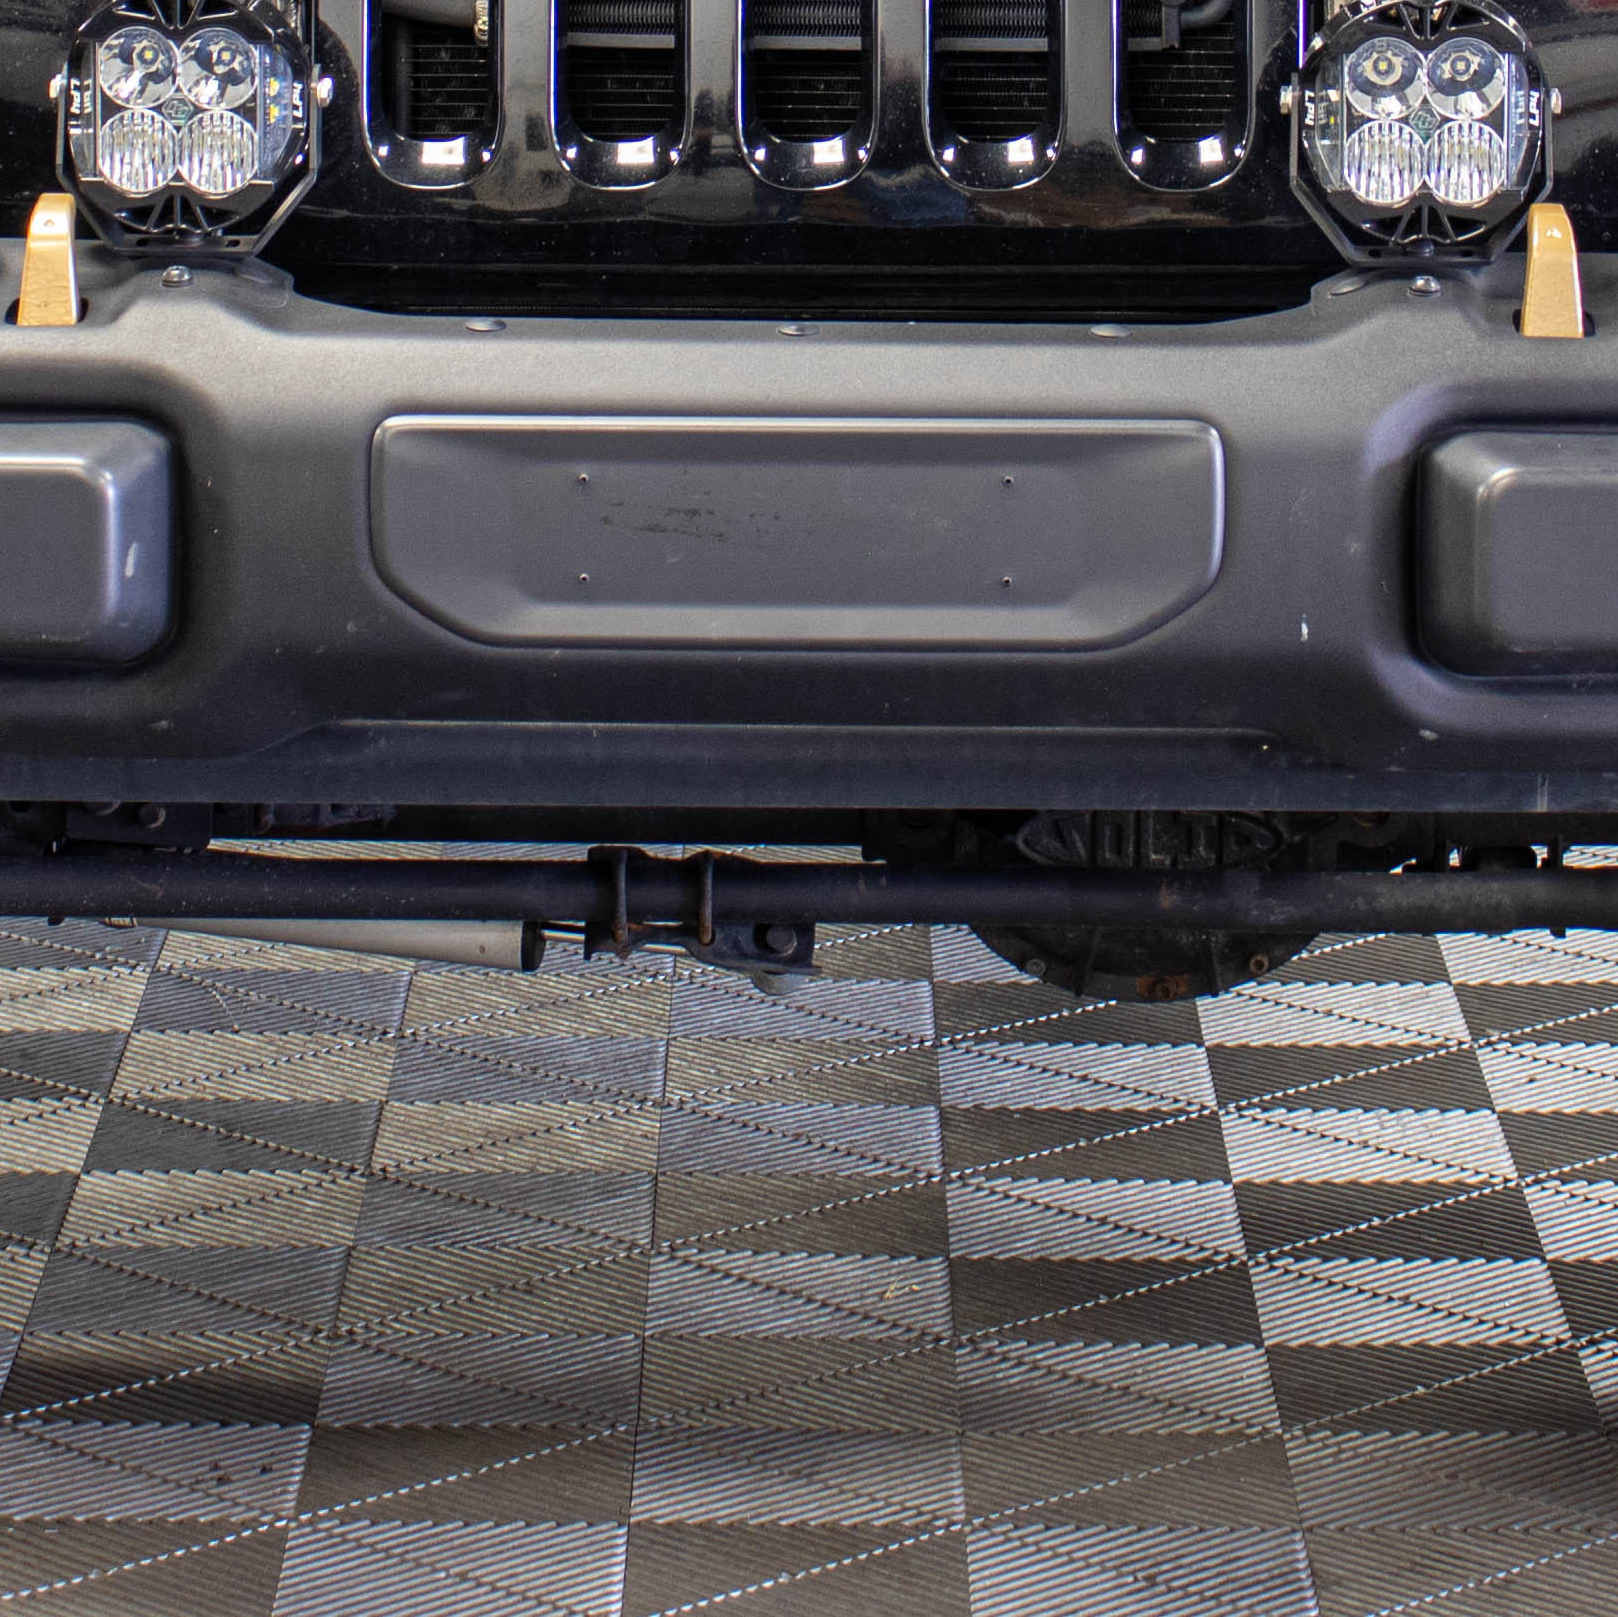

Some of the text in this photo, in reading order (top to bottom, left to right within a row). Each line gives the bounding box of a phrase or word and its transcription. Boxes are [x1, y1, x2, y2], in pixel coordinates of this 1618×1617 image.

[292, 81, 304, 118] LP4
[1303, 88, 1315, 126] LP4
[1528, 89, 1540, 127] LP4
